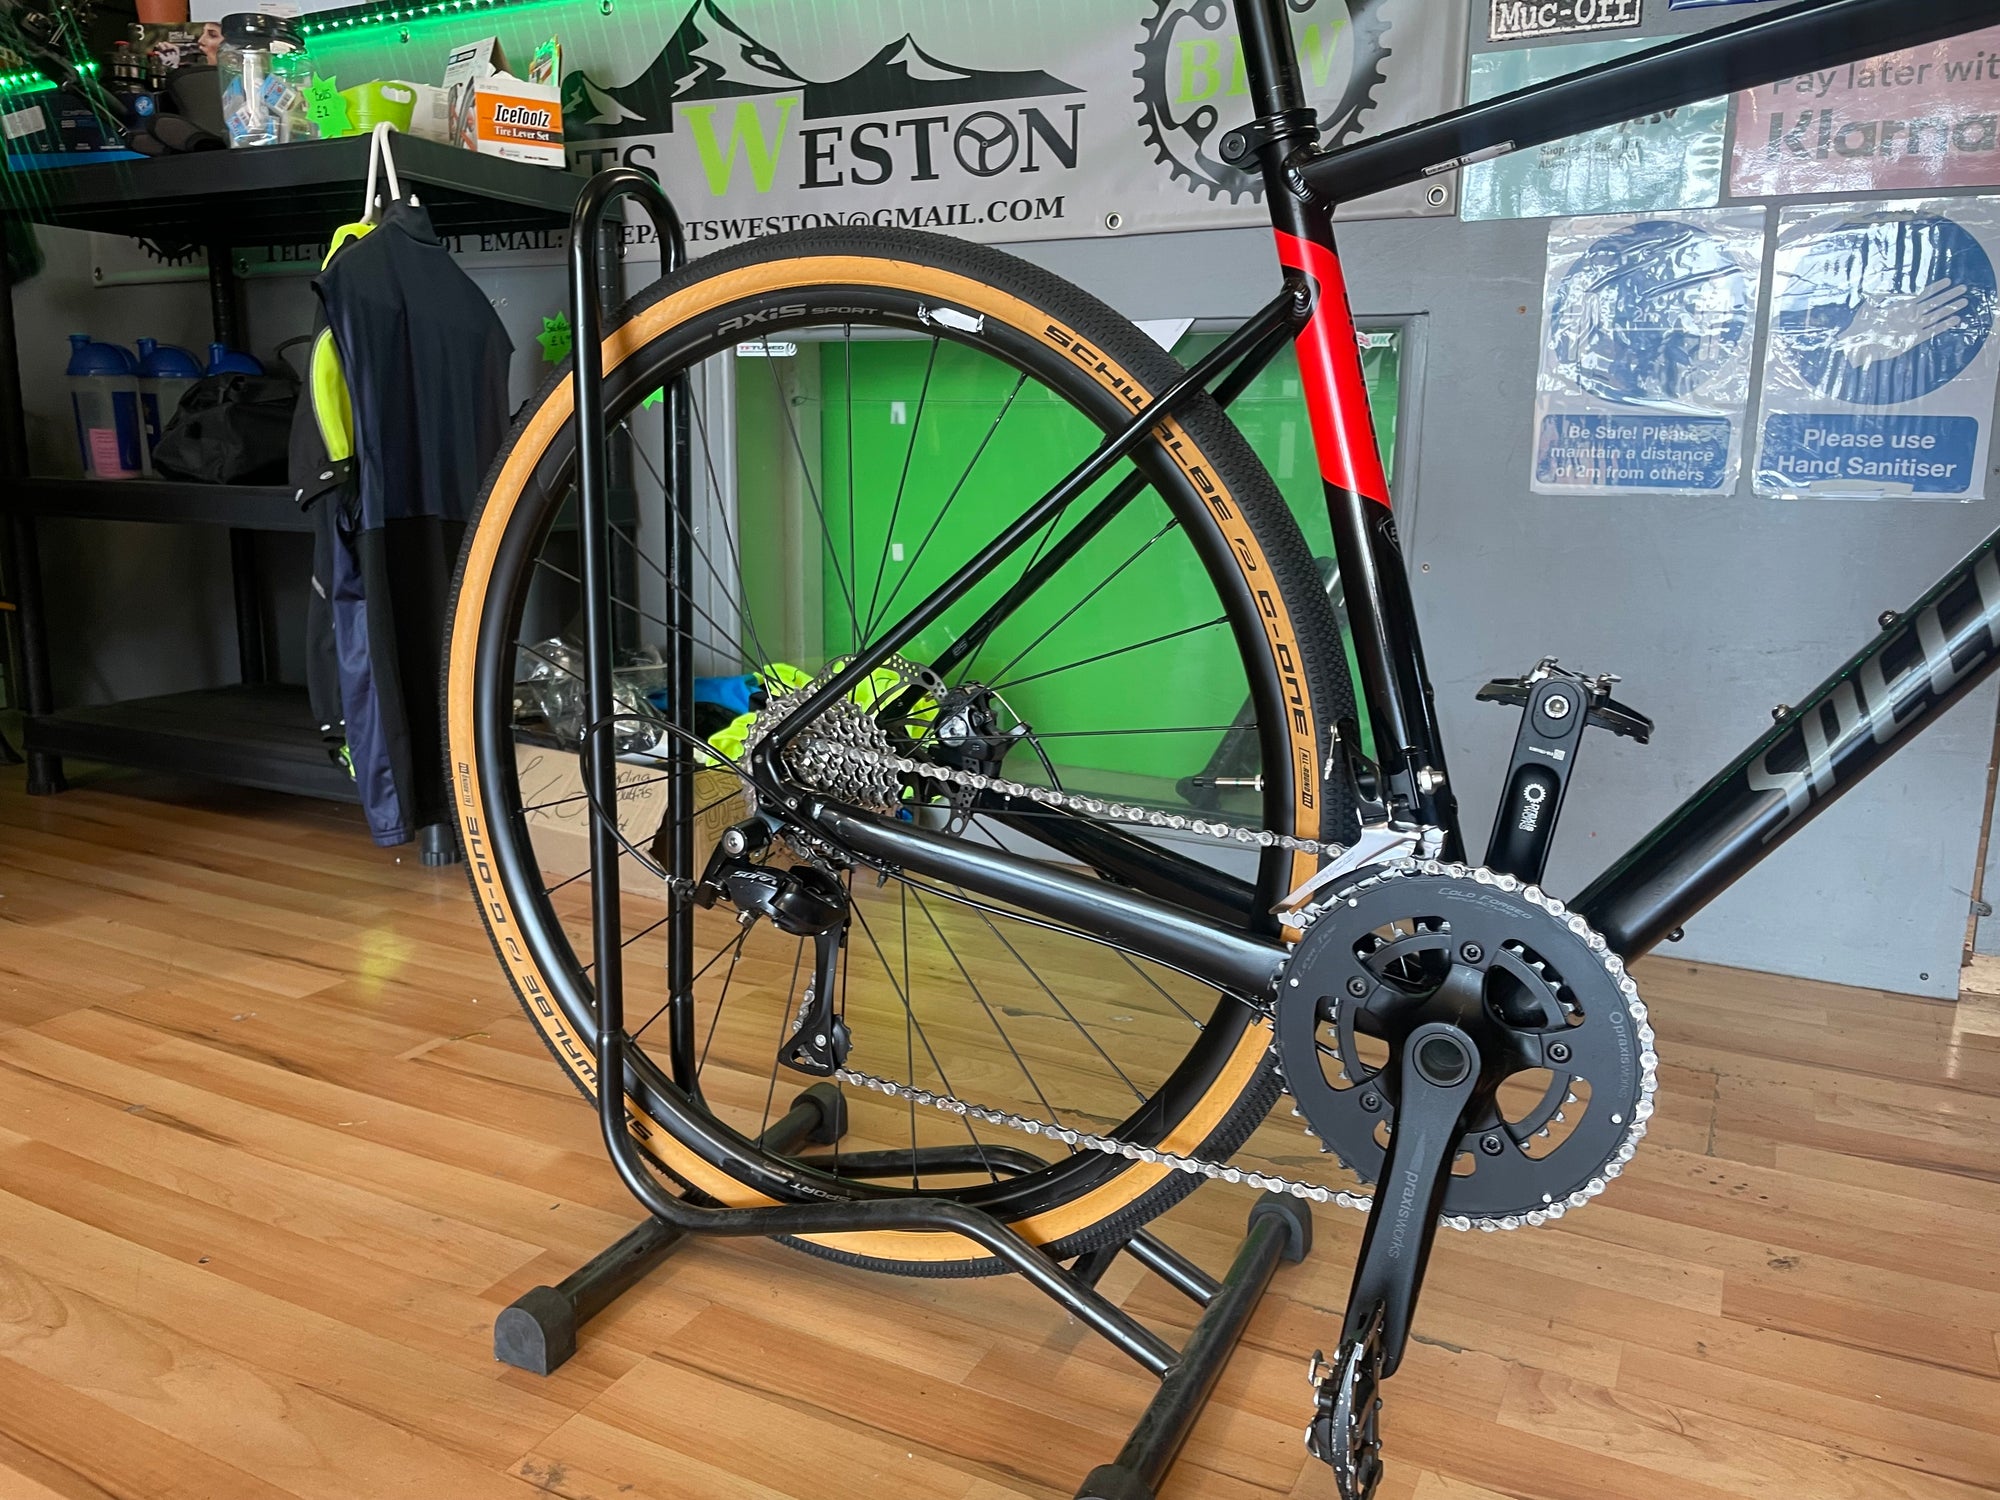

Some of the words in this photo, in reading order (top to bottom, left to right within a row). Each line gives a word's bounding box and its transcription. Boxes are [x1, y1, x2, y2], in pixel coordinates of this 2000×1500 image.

[1498, 0, 1632, 33] Muc-Off
[1847, 64, 1933, 91] later
[495, 104, 549, 127] IceToolz
[495, 126, 511, 136] Tire
[513, 128, 535, 139] Lever
[537, 131, 549, 141] Set
[1766, 107, 1999, 161] Klarna
[680, 96, 1086, 197] WESTON
[480, 231, 563, 252] EMAIL:
[810, 307, 878, 315] SPORT
[1568, 425, 1590, 439] Be
[1595, 425, 1637, 440] Safe!
[1643, 426, 1699, 442] Please
[1803, 428, 1887, 449] Please
[1890, 434, 1936, 449] use
[1551, 447, 1621, 460] maintain
[1625, 450, 1635, 460] a
[1641, 448, 1714, 462] distance
[1556, 465, 1571, 478] of
[1575, 466, 1601, 478] 2m
[1606, 466, 1644, 480] from
[1649, 467, 1704, 482] others
[1778, 454, 1840, 476] Hand
[1847, 455, 1957, 479] Sanitiser
[1257, 590, 1308, 736] G-ONE
[466, 815, 507, 924] G-ONE
